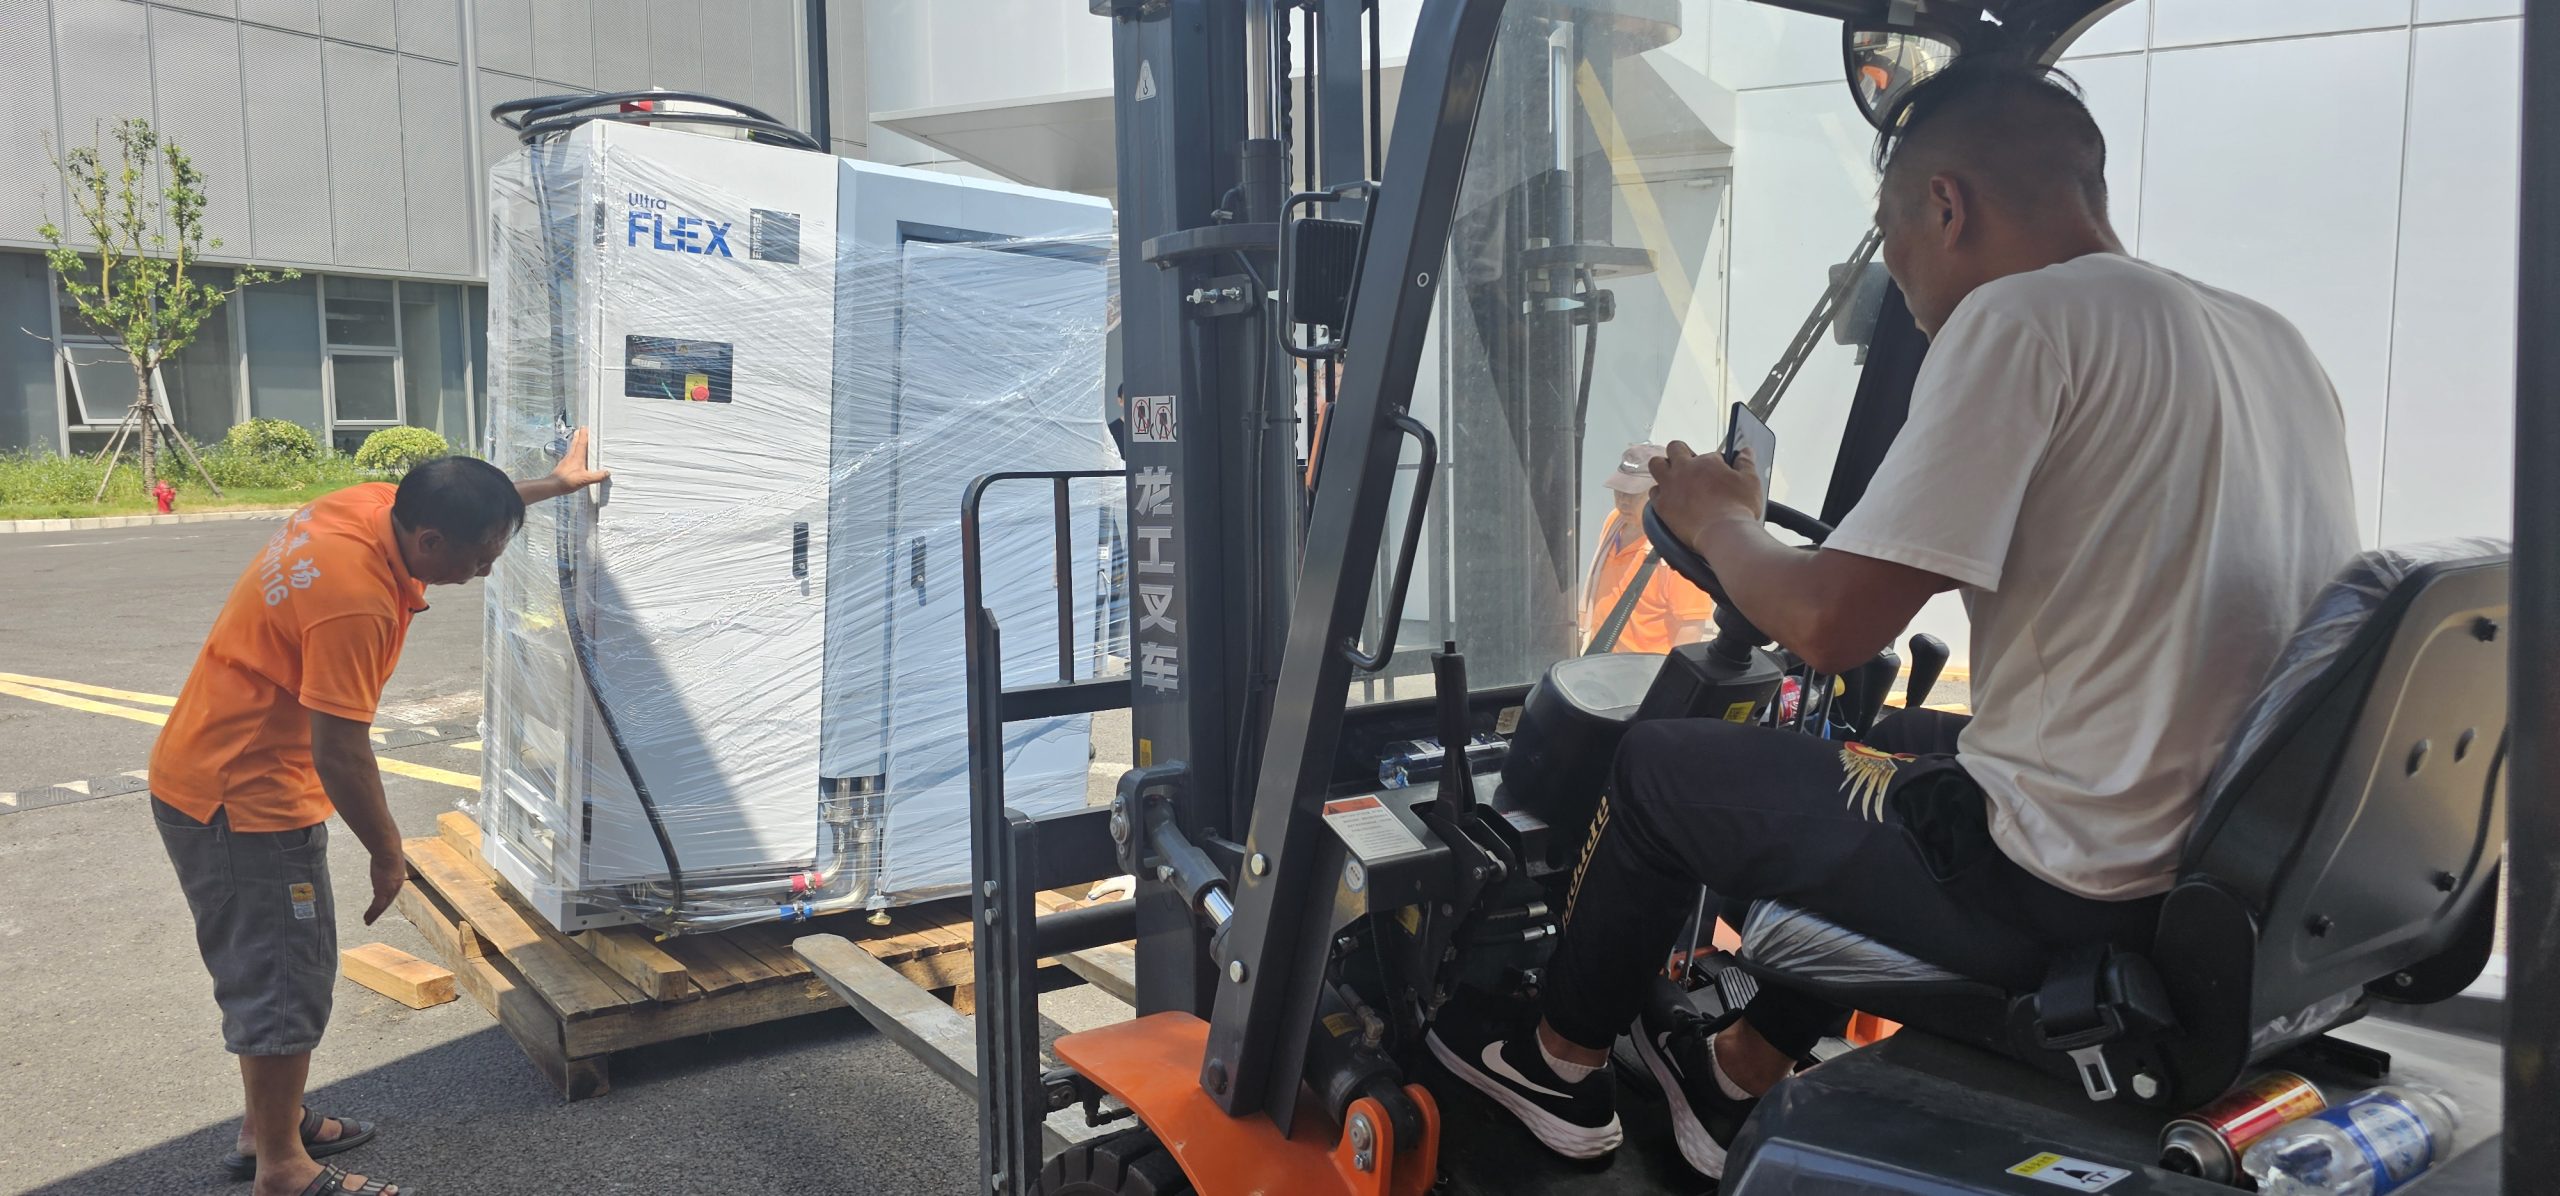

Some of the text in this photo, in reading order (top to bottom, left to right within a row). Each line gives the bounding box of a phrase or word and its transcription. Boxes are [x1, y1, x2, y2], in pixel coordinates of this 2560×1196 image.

[628, 192, 667, 210] Ultra
[628, 210, 733, 258] FLEX
[1135, 465, 1179, 695] 龙工叉车
